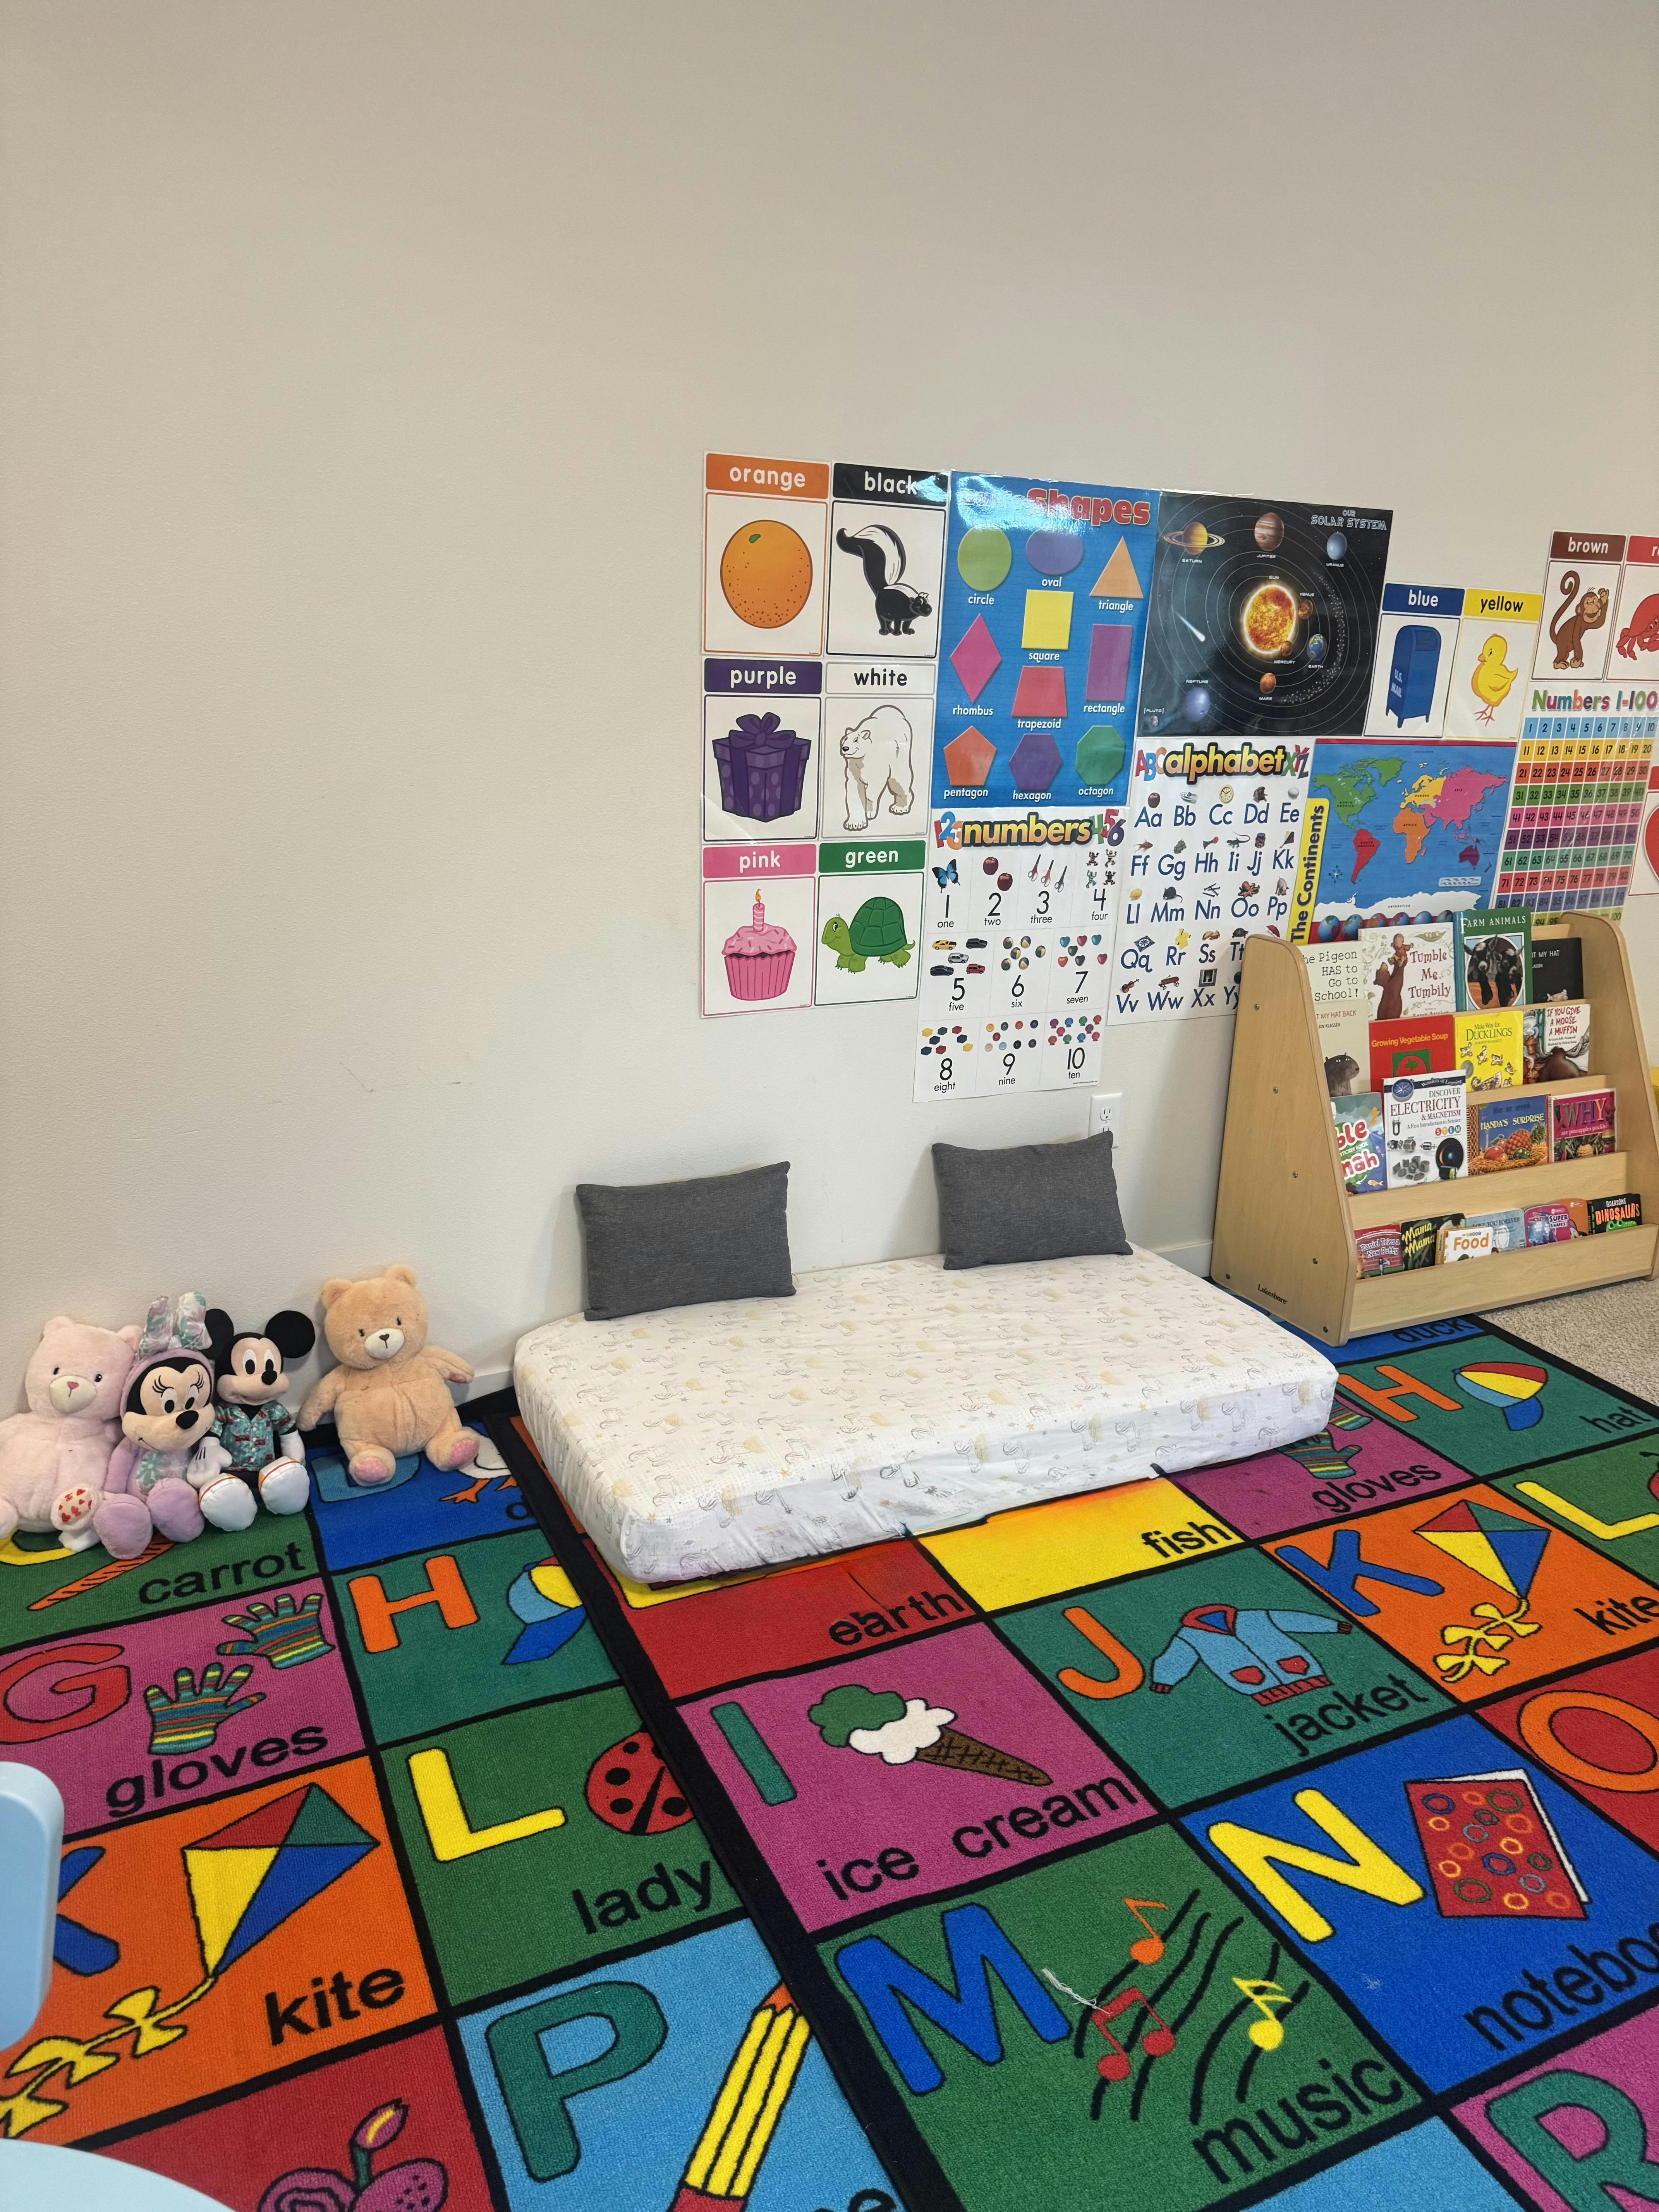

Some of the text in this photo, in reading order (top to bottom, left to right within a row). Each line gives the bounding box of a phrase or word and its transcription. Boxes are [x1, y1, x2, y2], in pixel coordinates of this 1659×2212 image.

[730, 467, 805, 491] orange
[865, 471, 917, 495] black
[1027, 488, 1151, 526] Shapes
[1311, 515, 1386, 531] SOLAR SYSTEM
[1568, 537, 1608, 554] brown
[1042, 577, 1061, 587] oval
[968, 594, 994, 605] circle
[1098, 600, 1133, 613] triangle
[1408, 589, 1439, 607] blue
[1480, 596, 1523, 613] yellow
[1029, 651, 1060, 663] square
[730, 666, 796, 689] purple
[854, 668, 907, 686] white
[1395, 669, 1403, 683] U.S.
[953, 706, 993, 716] rhombus
[1084, 703, 1125, 715] rectangle
[1532, 689, 1658, 711] Numbers 1-100
[1017, 718, 1061, 730] trapezoid
[1164, 743, 1286, 784] alphabet
[944, 787, 988, 799] pentagon
[1013, 790, 1051, 802] hexagon
[1078, 787, 1113, 798] octagon
[1134, 803, 1299, 828] Aa Bb Cc Dd Ee
[963, 812, 1092, 847] numbers
[740, 851, 780, 873] pink
[845, 850, 898, 868] green
[1131, 849, 1294, 881] Ff Gg Hh Ii Jj Kk
[1290, 805, 1324, 943] The Continents
[945, 895, 950, 918] 1
[987, 892, 1001, 916] 2
[1036, 891, 1049, 914] 3
[1094, 889, 1106, 911] 4
[1127, 897, 1287, 924] Ll Mm Nn Oo Pp
[984, 918, 1001, 926] two
[1031, 915, 1052, 924] three
[1092, 912, 1108, 921] four
[1460, 915, 1526, 934] FARM ANIMALS
[1121, 943, 1215, 973] Qq Rr Ss
[1319, 951, 1357, 963] Pigeon
[1410, 950, 1447, 963] Tumble
[1322, 965, 1357, 975] HAS to
[1421, 969, 1437, 981] Me
[952, 978, 965, 1001] 5
[1012, 974, 1024, 997] 6
[1075, 971, 1089, 994] 7
[1409, 985, 1450, 999] Tumbily
[1012, 1000, 1022, 1008] six
[1067, 996, 1088, 1004] seven
[1315, 988, 1358, 1001] School!
[949, 1002, 964, 1011] five
[1547, 1006, 1581, 1017] IF YOU GIVE
[1550, 1016, 1577, 1027] A MOOSE
[1554, 1025, 1577, 1035] MUFFIN
[1372, 1033, 1448, 1048] Growing Vegetable Soup
[1466, 1027, 1512, 1041] DUCKLINGS
[940, 1058, 952, 1080] 8
[1003, 1053, 1015, 1075] 9
[1067, 1047, 1085, 1070] 10
[934, 1082, 955, 1093] eight
[1429, 1087, 1460, 1097] DISCOVER
[1391, 1096, 1461, 1116] ELECTRICITY
[1427, 1109, 1461, 1120] MAGNETISM
[1563, 1098, 1606, 1126] WHY
[1512, 1113, 1544, 1125] SURPRISE
[1595, 1203, 1640, 1225] DINOSAURS
[1402, 1223, 1432, 1245] Mama
[1454, 1233, 1489, 1250] Food
[1360, 1239, 1379, 1252] Daniel
[1367, 1247, 1399, 1258] New Potty
[1405, 1235, 1435, 1257] Mama
[1258, 1284, 1288, 1304] Lakeshore
[1337, 1364, 1463, 1422] H
[1579, 1405, 1651, 1433] hat
[1312, 1462, 1441, 1513] gloves
[1142, 1520, 1235, 1558] fish
[139, 1541, 307, 1605] carrot
[1274, 1529, 1444, 1617] K
[348, 1554, 479, 1654] H
[1574, 1595, 1659, 1635] kite
[829, 1590, 964, 1647] earth
[1057, 1606, 1144, 1699] J
[0, 1643, 131, 1745] G
[1264, 1673, 1430, 1758] jacket
[105, 1726, 328, 1817] gloves
[407, 1747, 567, 1863] L
[818, 1776, 1137, 1902] ice cream
[1207, 1788, 1424, 1943] N
[572, 1862, 711, 1935] lady
[265, 1968, 405, 2046] kite
[835, 1903, 1073, 2096] M
[485, 1980, 668, 2184] P
[1191, 2057, 1398, 2185] music
